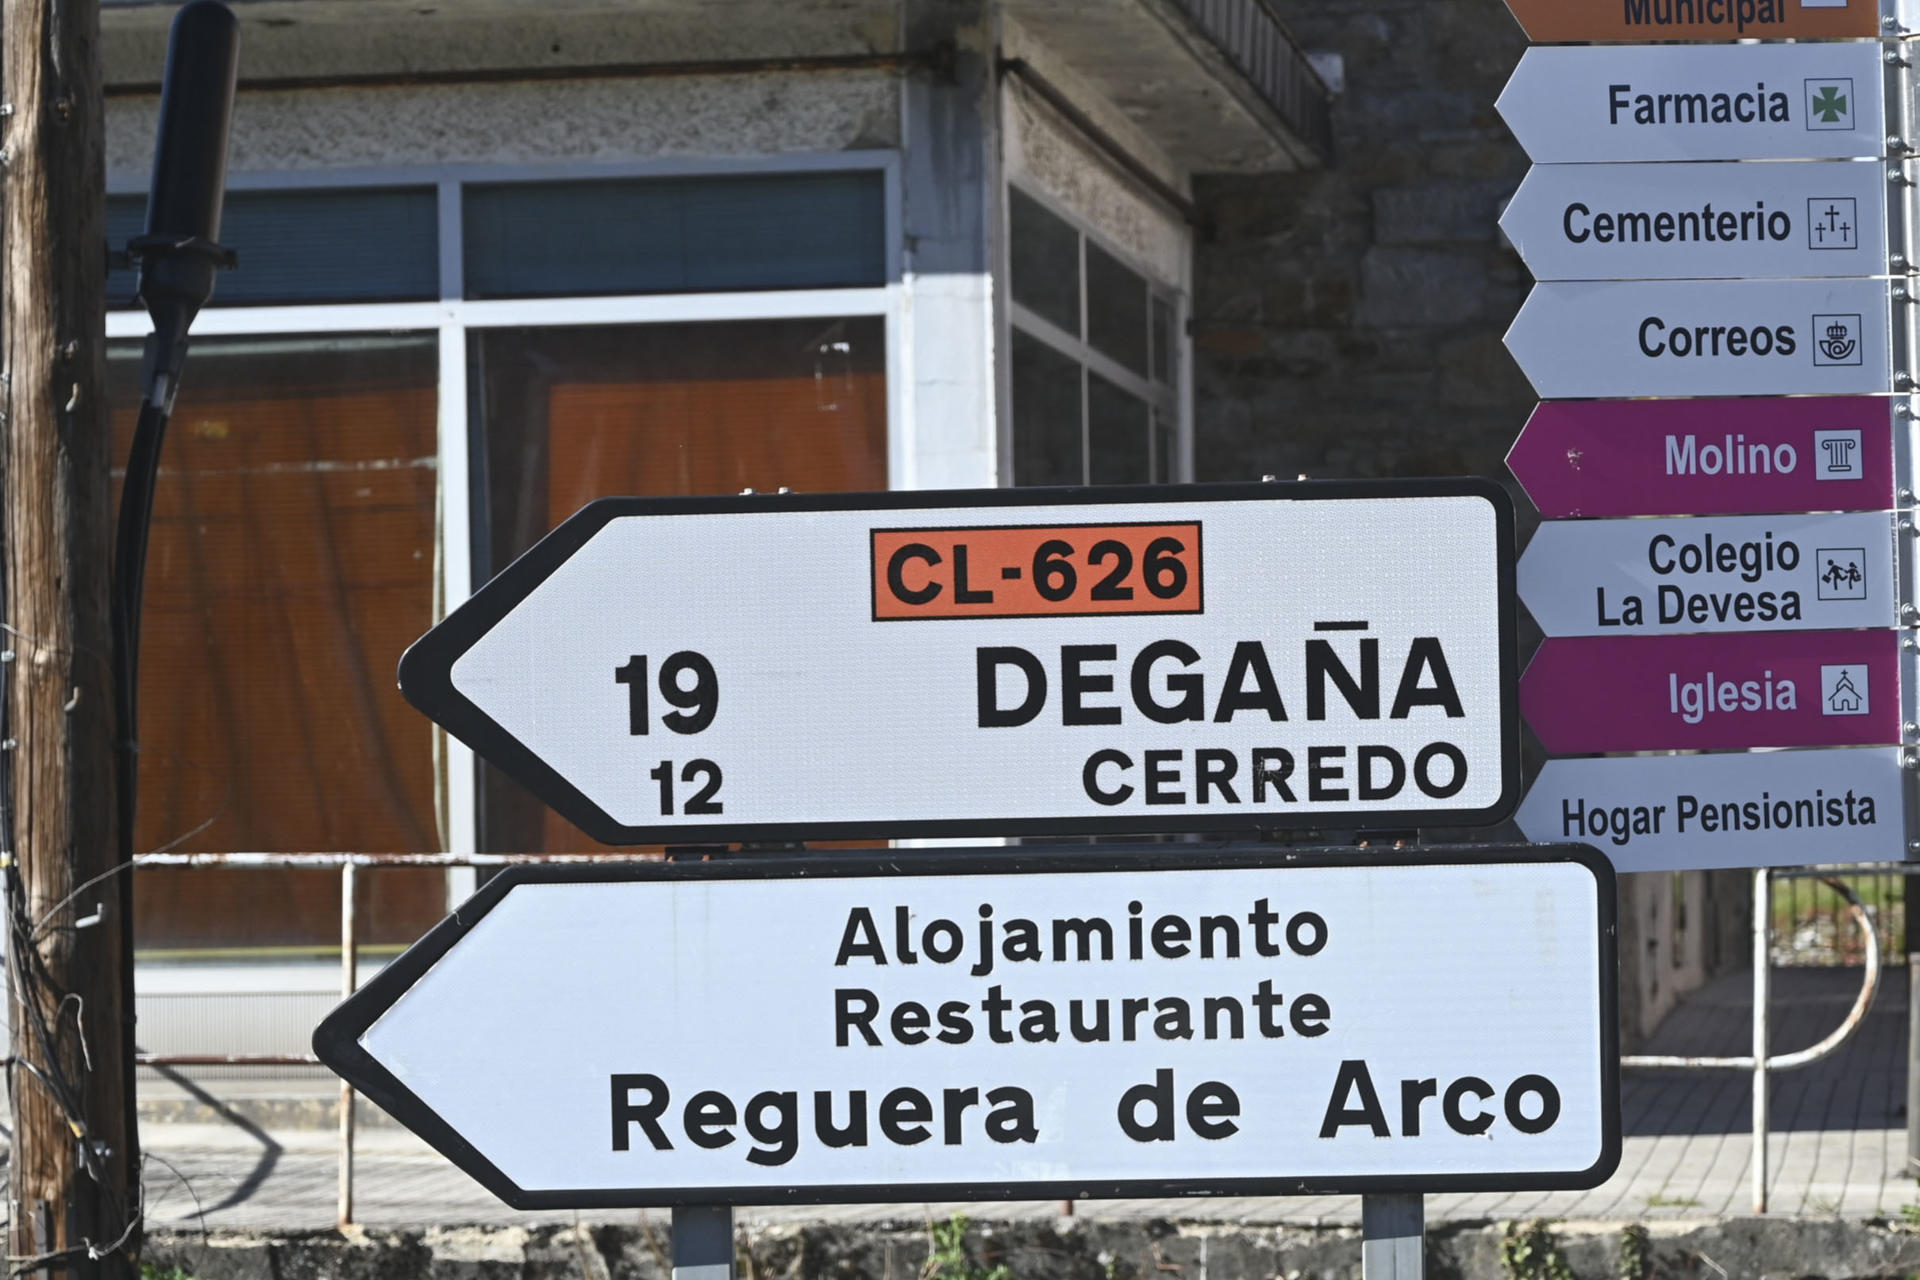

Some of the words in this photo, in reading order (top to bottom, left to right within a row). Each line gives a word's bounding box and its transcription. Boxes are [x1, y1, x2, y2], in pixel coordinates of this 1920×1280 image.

[1624, 0, 1785, 33] Municipal
[1609, 83, 1790, 125] Farmacia
[1563, 201, 1791, 244] Cementerio
[1639, 317, 1797, 358] Correos
[1665, 434, 1797, 475] Molino
[887, 537, 1188, 605] CL-626
[1649, 532, 1800, 582] Colegio
[1597, 586, 1644, 627] La
[1658, 585, 1802, 625] Devesa
[615, 651, 719, 736] 19
[977, 620, 1466, 728] DEGAÑA
[1669, 671, 1797, 724] Iglesia
[651, 759, 724, 816] 12
[1083, 742, 1469, 806] CERREDO
[1562, 798, 1666, 846] Hogar
[1677, 790, 1877, 833] Pensionista
[835, 898, 1329, 977] Alojamiento
[835, 980, 1331, 1048] Restaurante
[611, 1074, 1040, 1167] Reguera
[1118, 1069, 1241, 1143] de
[1319, 1060, 1561, 1139] Arco
